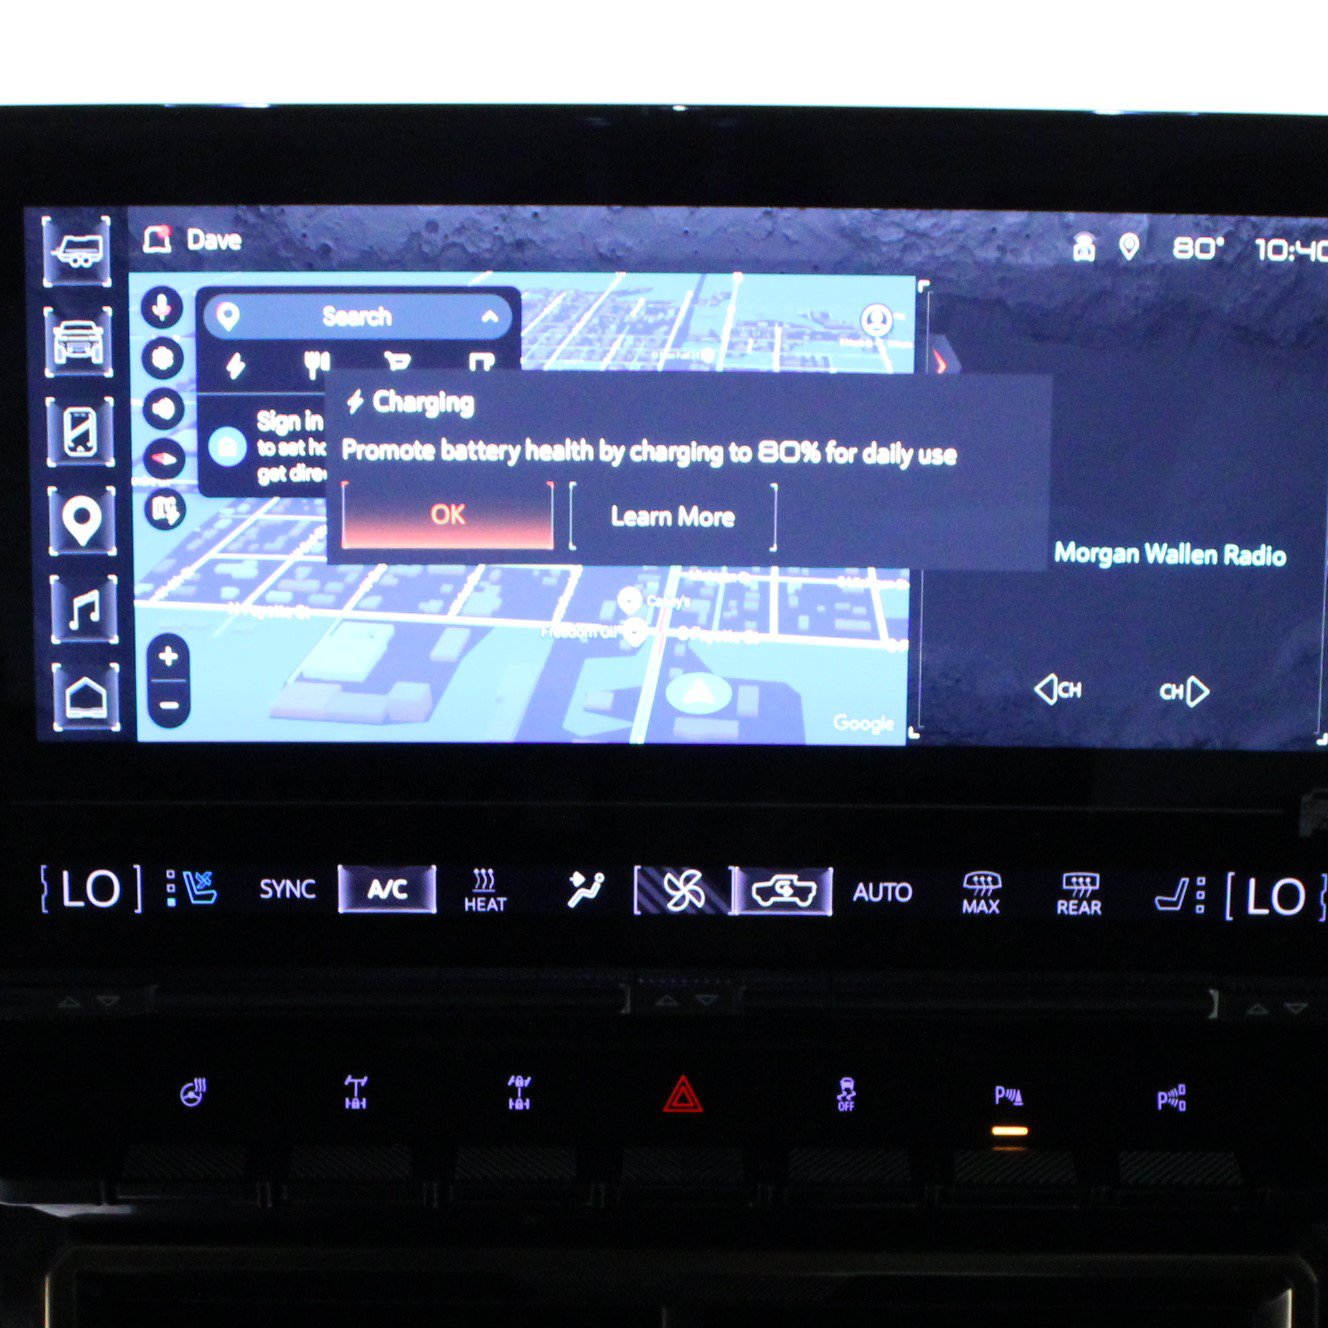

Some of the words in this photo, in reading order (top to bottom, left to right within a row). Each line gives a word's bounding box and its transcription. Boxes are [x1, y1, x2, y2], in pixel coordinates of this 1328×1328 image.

[187, 228, 243, 251] Dave
[322, 305, 392, 327] Search
[373, 389, 475, 419] Charging
[257, 410, 301, 436] Sign
[305, 409, 324, 431] in
[257, 439, 276, 457] to
[278, 439, 306, 457] set
[342, 438, 436, 461] Promote
[441, 437, 521, 467] battery
[525, 438, 594, 461] health
[599, 438, 625, 467] by
[630, 438, 724, 468] charging
[729, 441, 752, 462] to
[757, 440, 821, 463] 80%
[825, 440, 857, 463] for
[862, 441, 914, 470] daily
[918, 447, 958, 466] use
[257, 465, 287, 486] get
[430, 503, 465, 525] OK
[611, 505, 672, 528] Learn
[678, 505, 736, 528] More
[1054, 541, 1140, 569] Morgan
[1144, 542, 1218, 565] Wallen
[1224, 543, 1288, 567] Radio
[1058, 681, 1083, 699] CH
[1159, 683, 1184, 700] CH
[833, 713, 896, 736] Google
[61, 869, 121, 909] LO
[259, 879, 317, 900] SYNC
[367, 878, 409, 900] A/C
[852, 881, 913, 903] AUTO
[1246, 877, 1307, 916] LO
[464, 897, 508, 913] HEAT
[962, 899, 1001, 915] MAX
[1056, 899, 1102, 916] REAR
[837, 1101, 855, 1112] OFF
